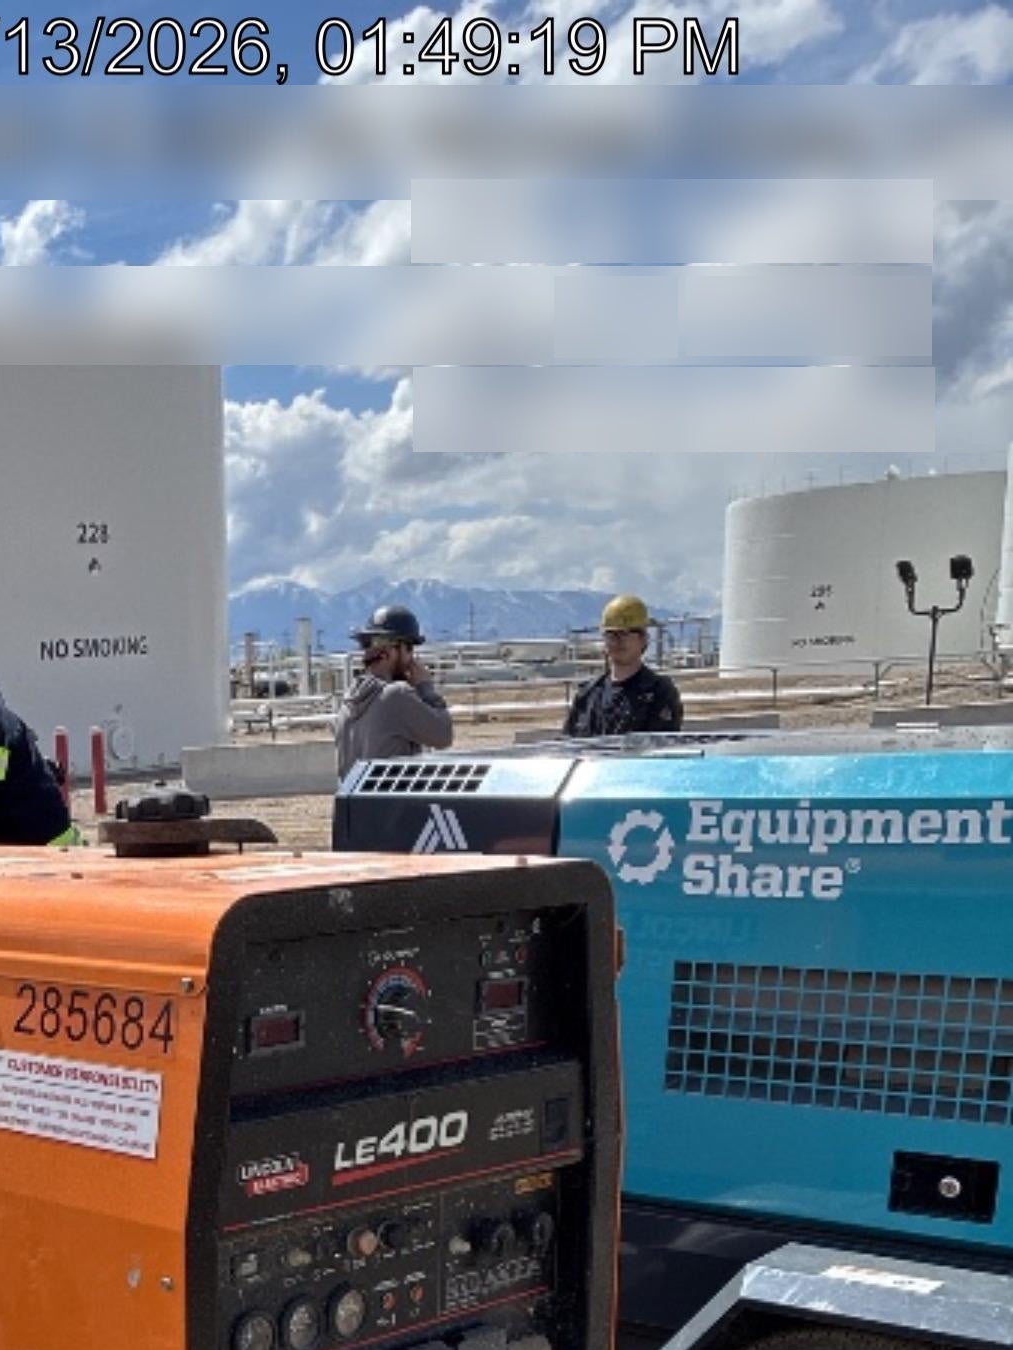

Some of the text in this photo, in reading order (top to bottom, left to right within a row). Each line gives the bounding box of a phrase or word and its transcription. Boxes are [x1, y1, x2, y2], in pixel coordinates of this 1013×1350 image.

[40, 634, 148, 661] NO SMOKING
[685, 799, 1013, 853] Equipment
[13, 982, 174, 1054] 285684
[333, 1109, 469, 1171] LE400
